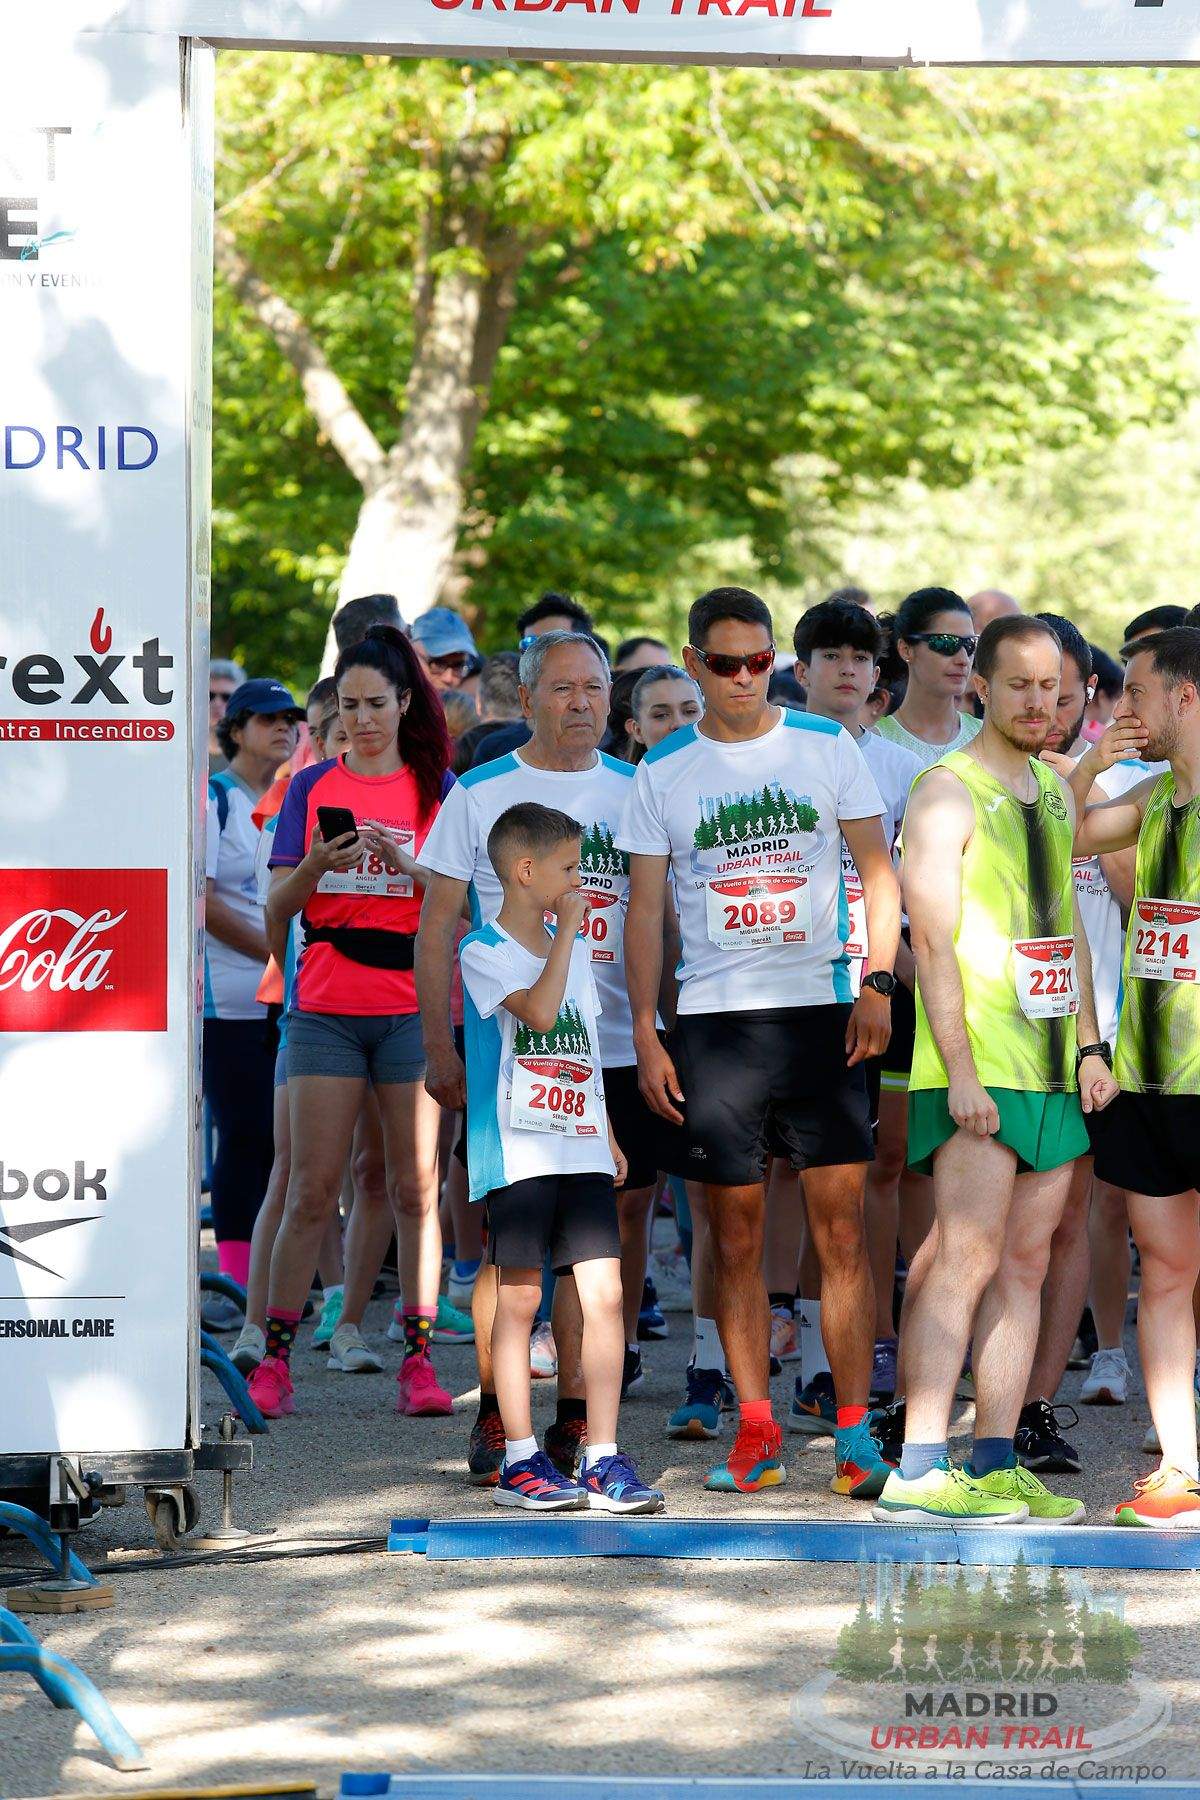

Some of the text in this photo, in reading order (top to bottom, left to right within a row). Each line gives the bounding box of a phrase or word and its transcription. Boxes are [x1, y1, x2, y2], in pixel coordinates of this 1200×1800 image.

[27, 274, 36, 287] Y
[5, 425, 159, 470] DRID
[0, 637, 174, 705] ext
[0, 722, 169, 739] tra Incendios
[726, 838, 790, 860] MADRID
[716, 855, 762, 874] URBAN
[765, 850, 804, 865] TRAIL
[694, 879, 706, 890] La
[723, 900, 797, 931] 2089
[739, 928, 761, 936] MIGUEL
[1135, 928, 1190, 960] 2214
[1029, 966, 1074, 996] 2221
[528, 1083, 586, 1118] 2088
[552, 1113, 569, 1121] SERGIO
[72, 1318, 115, 1338] CARE
